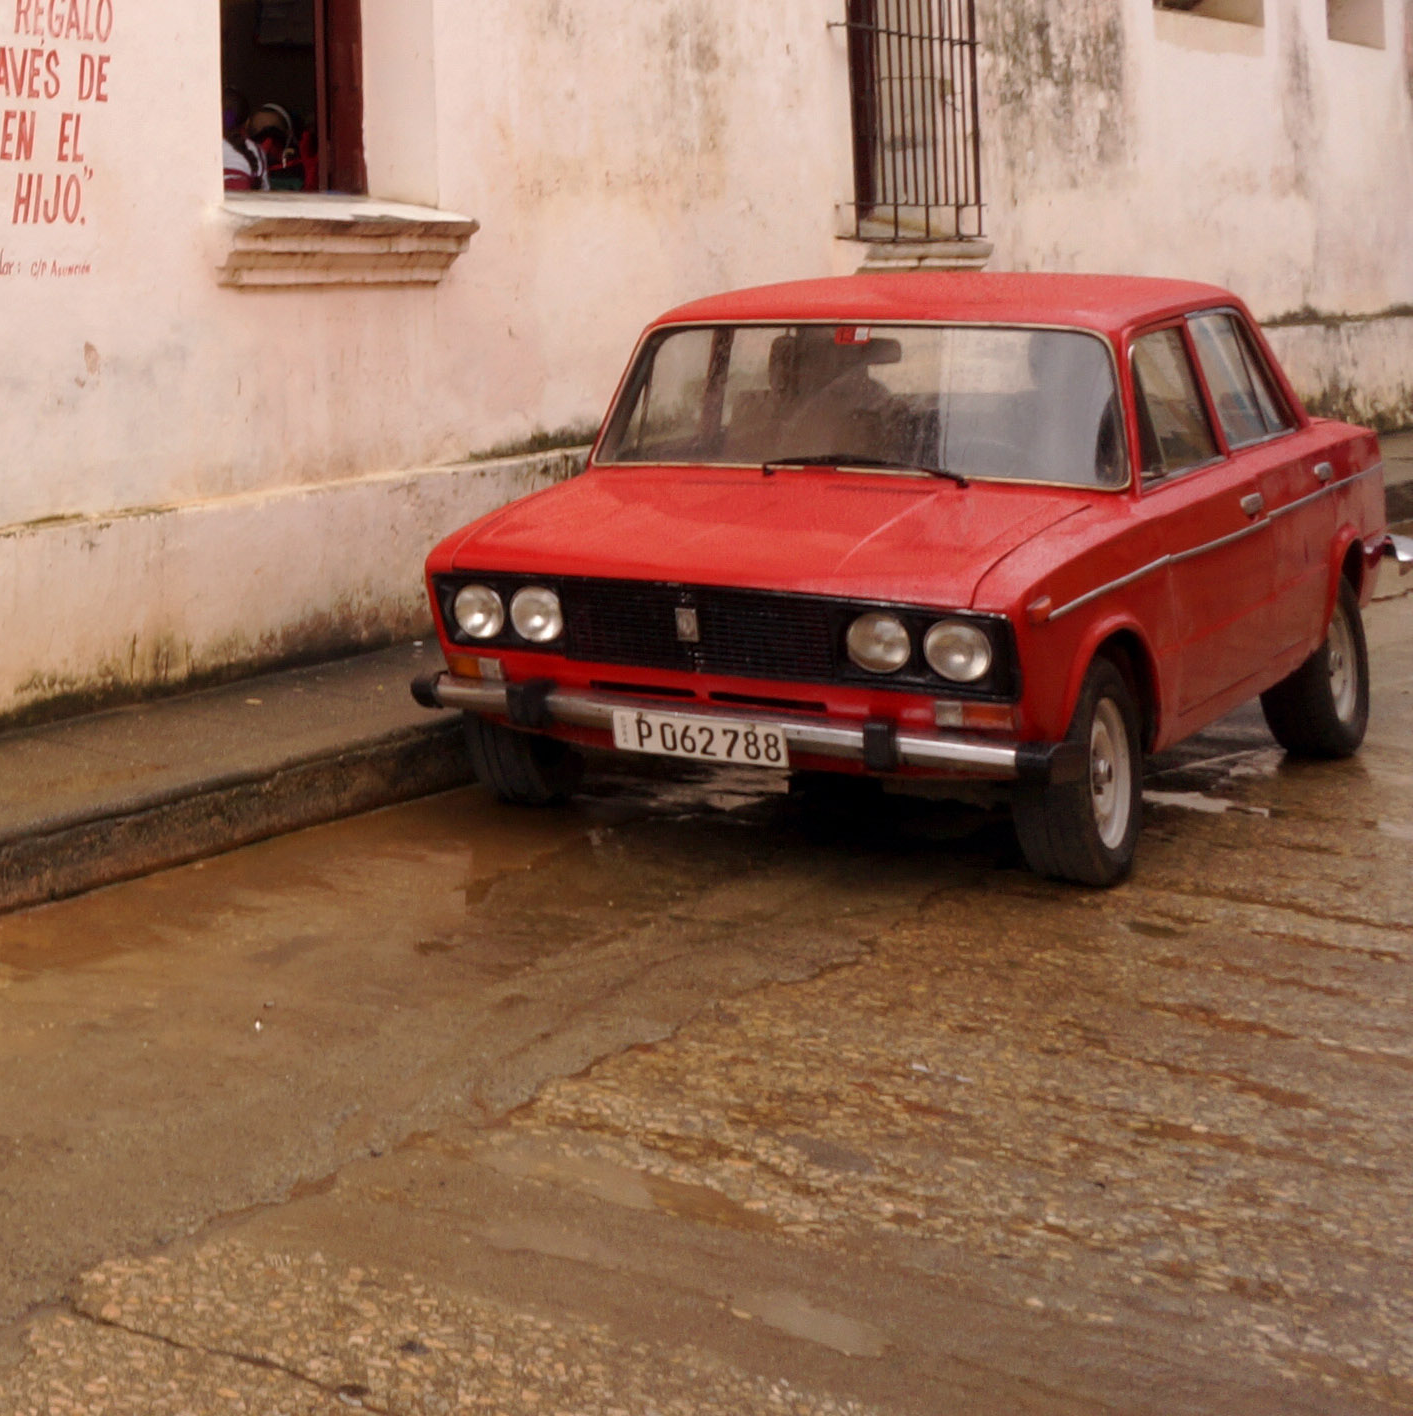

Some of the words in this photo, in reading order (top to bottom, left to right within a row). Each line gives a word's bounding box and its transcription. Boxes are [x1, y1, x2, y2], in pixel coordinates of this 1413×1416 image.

[78, 53, 111, 103] DE
[0, 109, 36, 161] EN
[57, 112, 84, 163] EL
[636, 717, 782, 763] P062788
